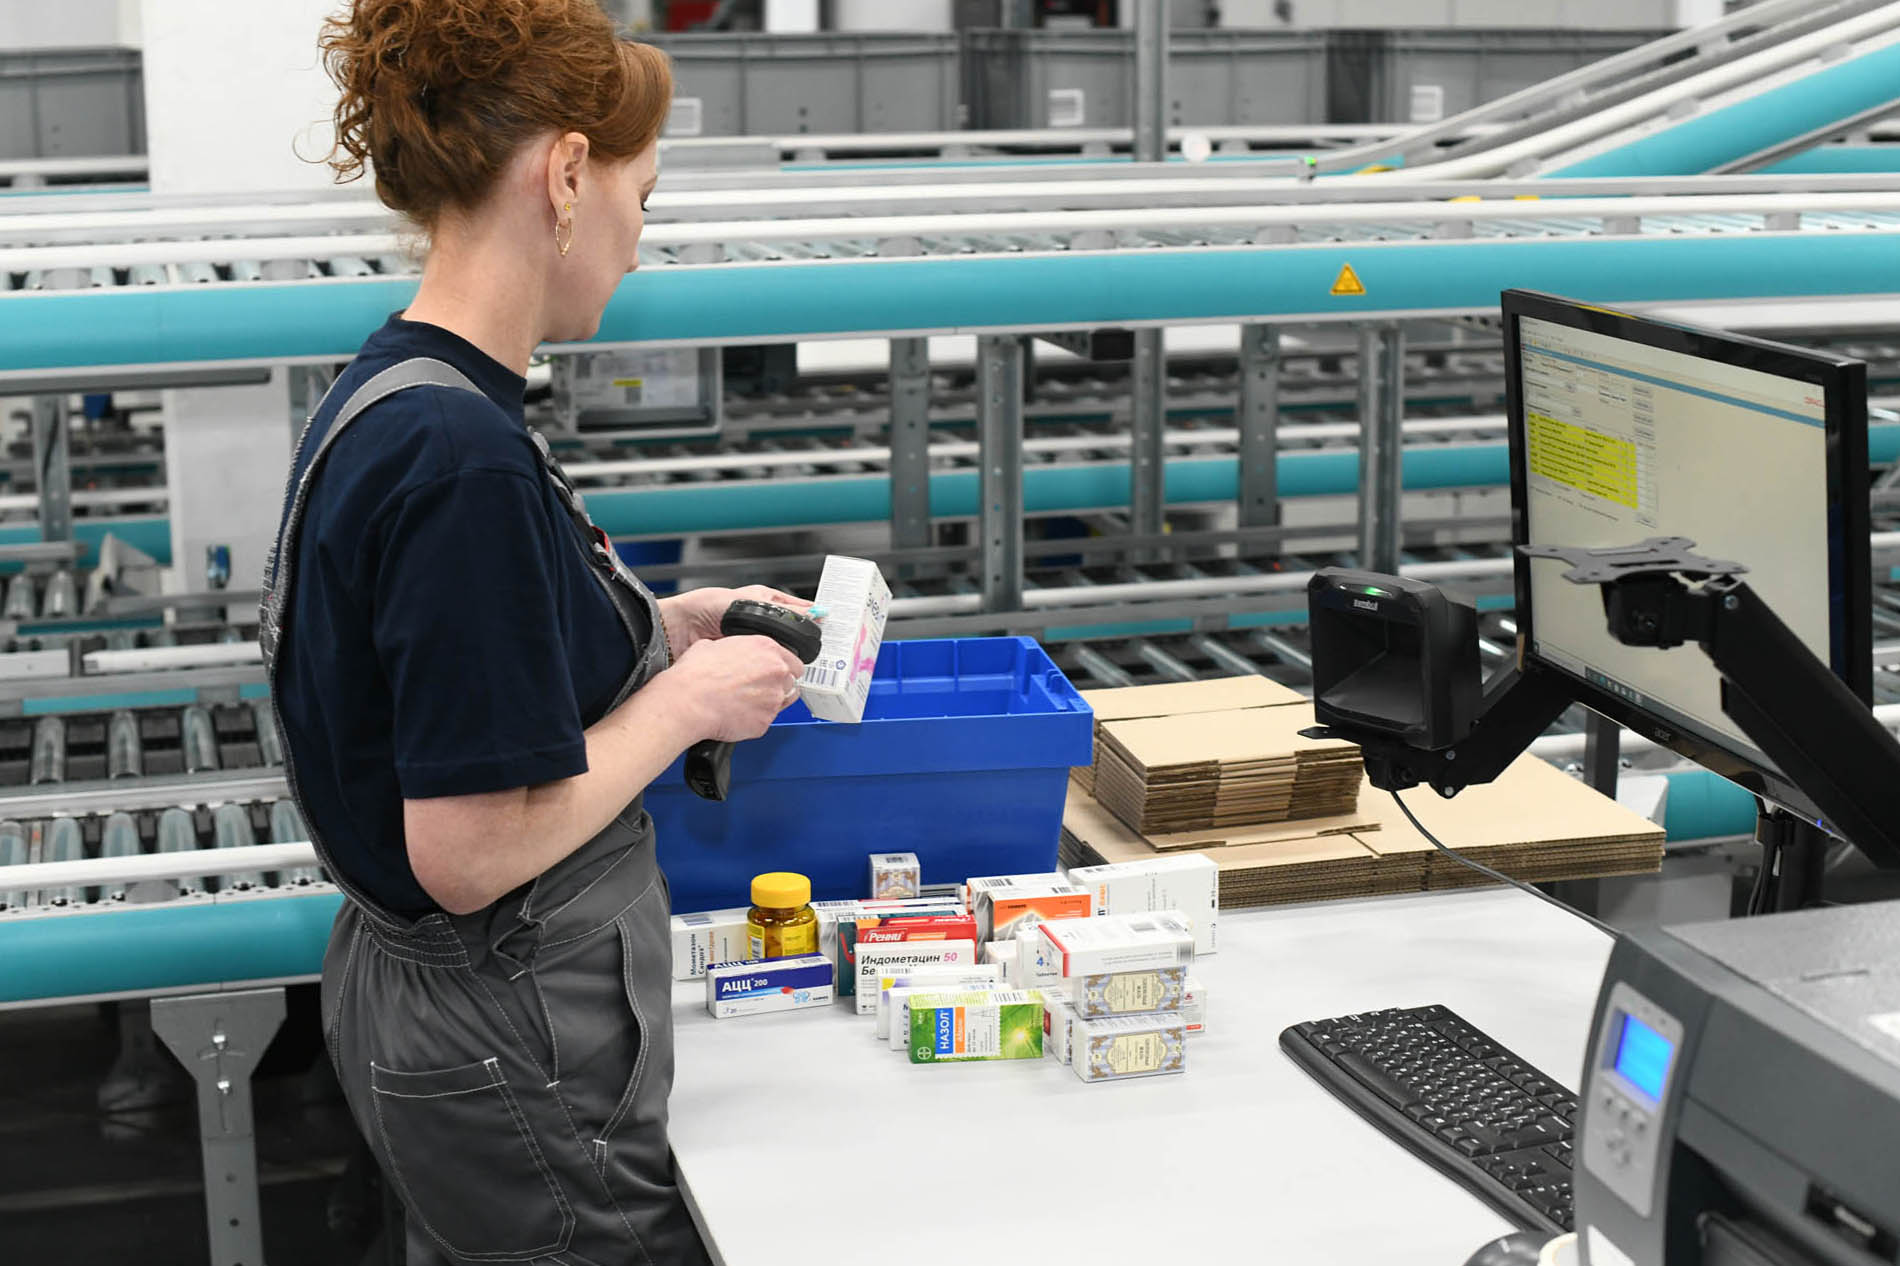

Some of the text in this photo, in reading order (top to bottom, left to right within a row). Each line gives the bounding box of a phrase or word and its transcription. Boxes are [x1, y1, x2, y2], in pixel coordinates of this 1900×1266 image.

[868, 931, 902, 942] Ренни
[861, 952, 958, 966] Индометацин 50
[754, 978, 768, 987] 200
[939, 1012, 950, 1050] НАЗОЛ
